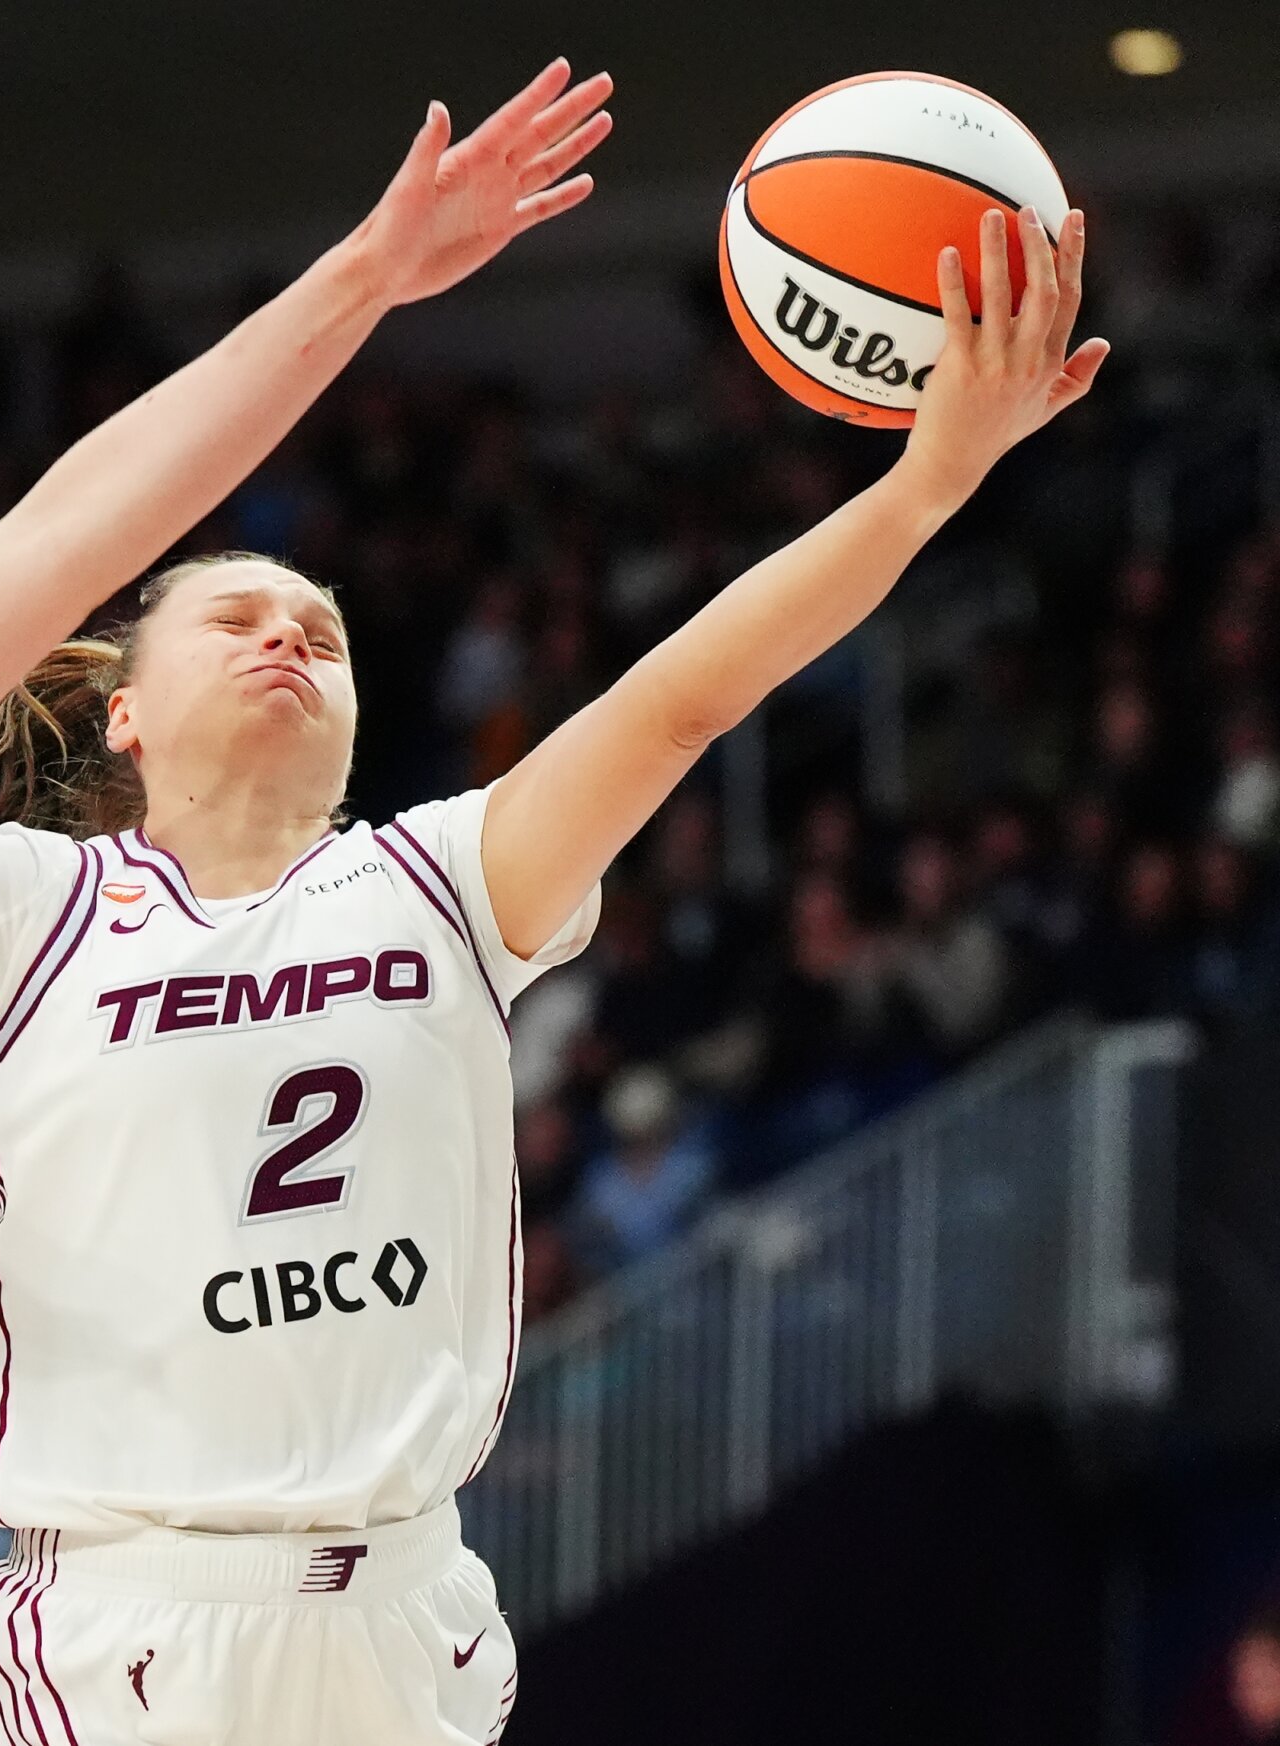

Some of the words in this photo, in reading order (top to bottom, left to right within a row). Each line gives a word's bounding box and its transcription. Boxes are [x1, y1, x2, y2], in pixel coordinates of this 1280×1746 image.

[94, 948, 431, 1047] TEMPO
[243, 1063, 366, 1221] 2
[202, 1251, 367, 1334] CIBC
